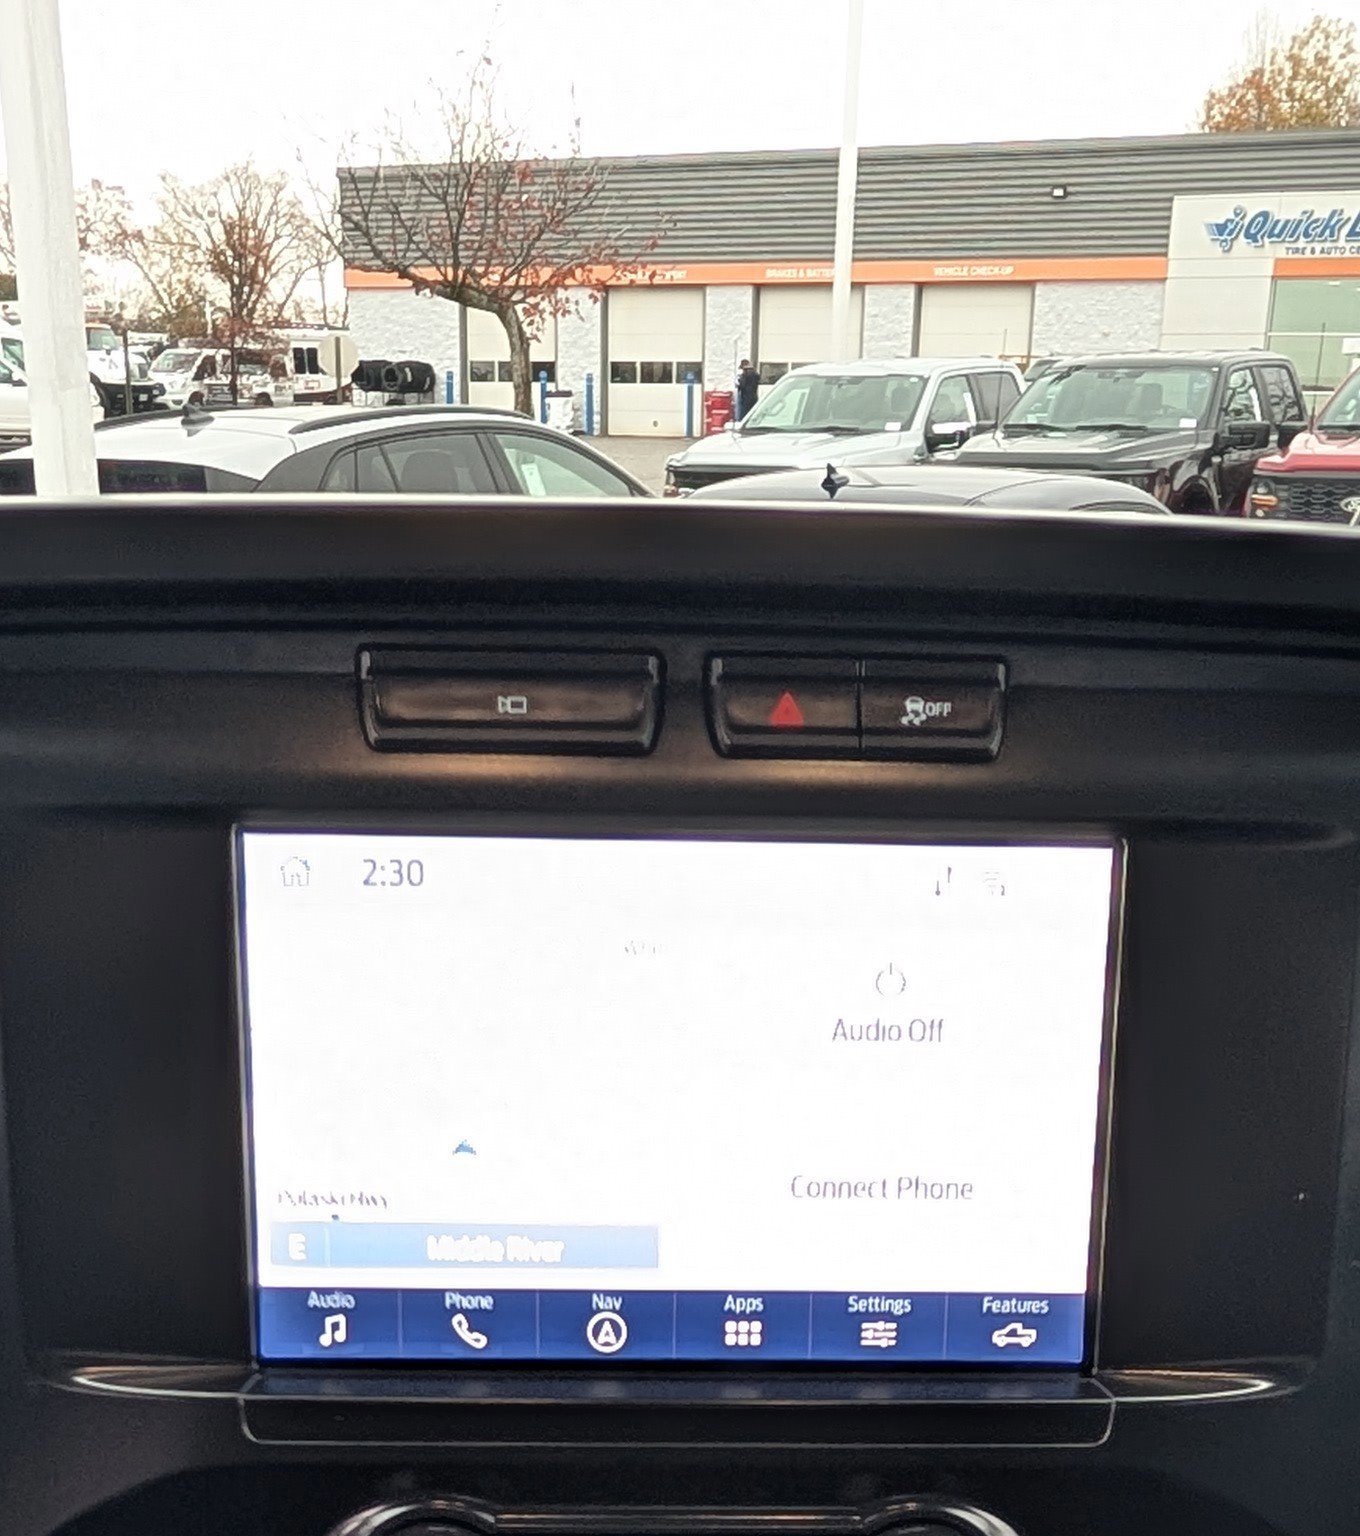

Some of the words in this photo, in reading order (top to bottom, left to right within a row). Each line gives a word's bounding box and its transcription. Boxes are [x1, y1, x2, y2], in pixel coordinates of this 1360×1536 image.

[1243, 209, 1346, 244] Quick
[1285, 246, 1307, 256] TIRE
[1319, 245, 1347, 255] AUTO
[925, 701, 952, 717] OFF
[362, 858, 425, 888] 2:30
[831, 1017, 903, 1042] Audio
[908, 1017, 944, 1043] Off
[791, 1175, 889, 1201] Connect
[897, 1176, 974, 1201] Phone
[288, 1233, 307, 1260] E
[426, 1234, 504, 1262] Middle
[506, 1235, 566, 1263] River
[307, 1291, 356, 1310] Audio
[444, 1292, 495, 1311] Phone
[592, 1294, 622, 1311] Nav
[723, 1294, 764, 1314] Apps
[847, 1295, 912, 1315] Settings
[981, 1296, 1050, 1314] Features
